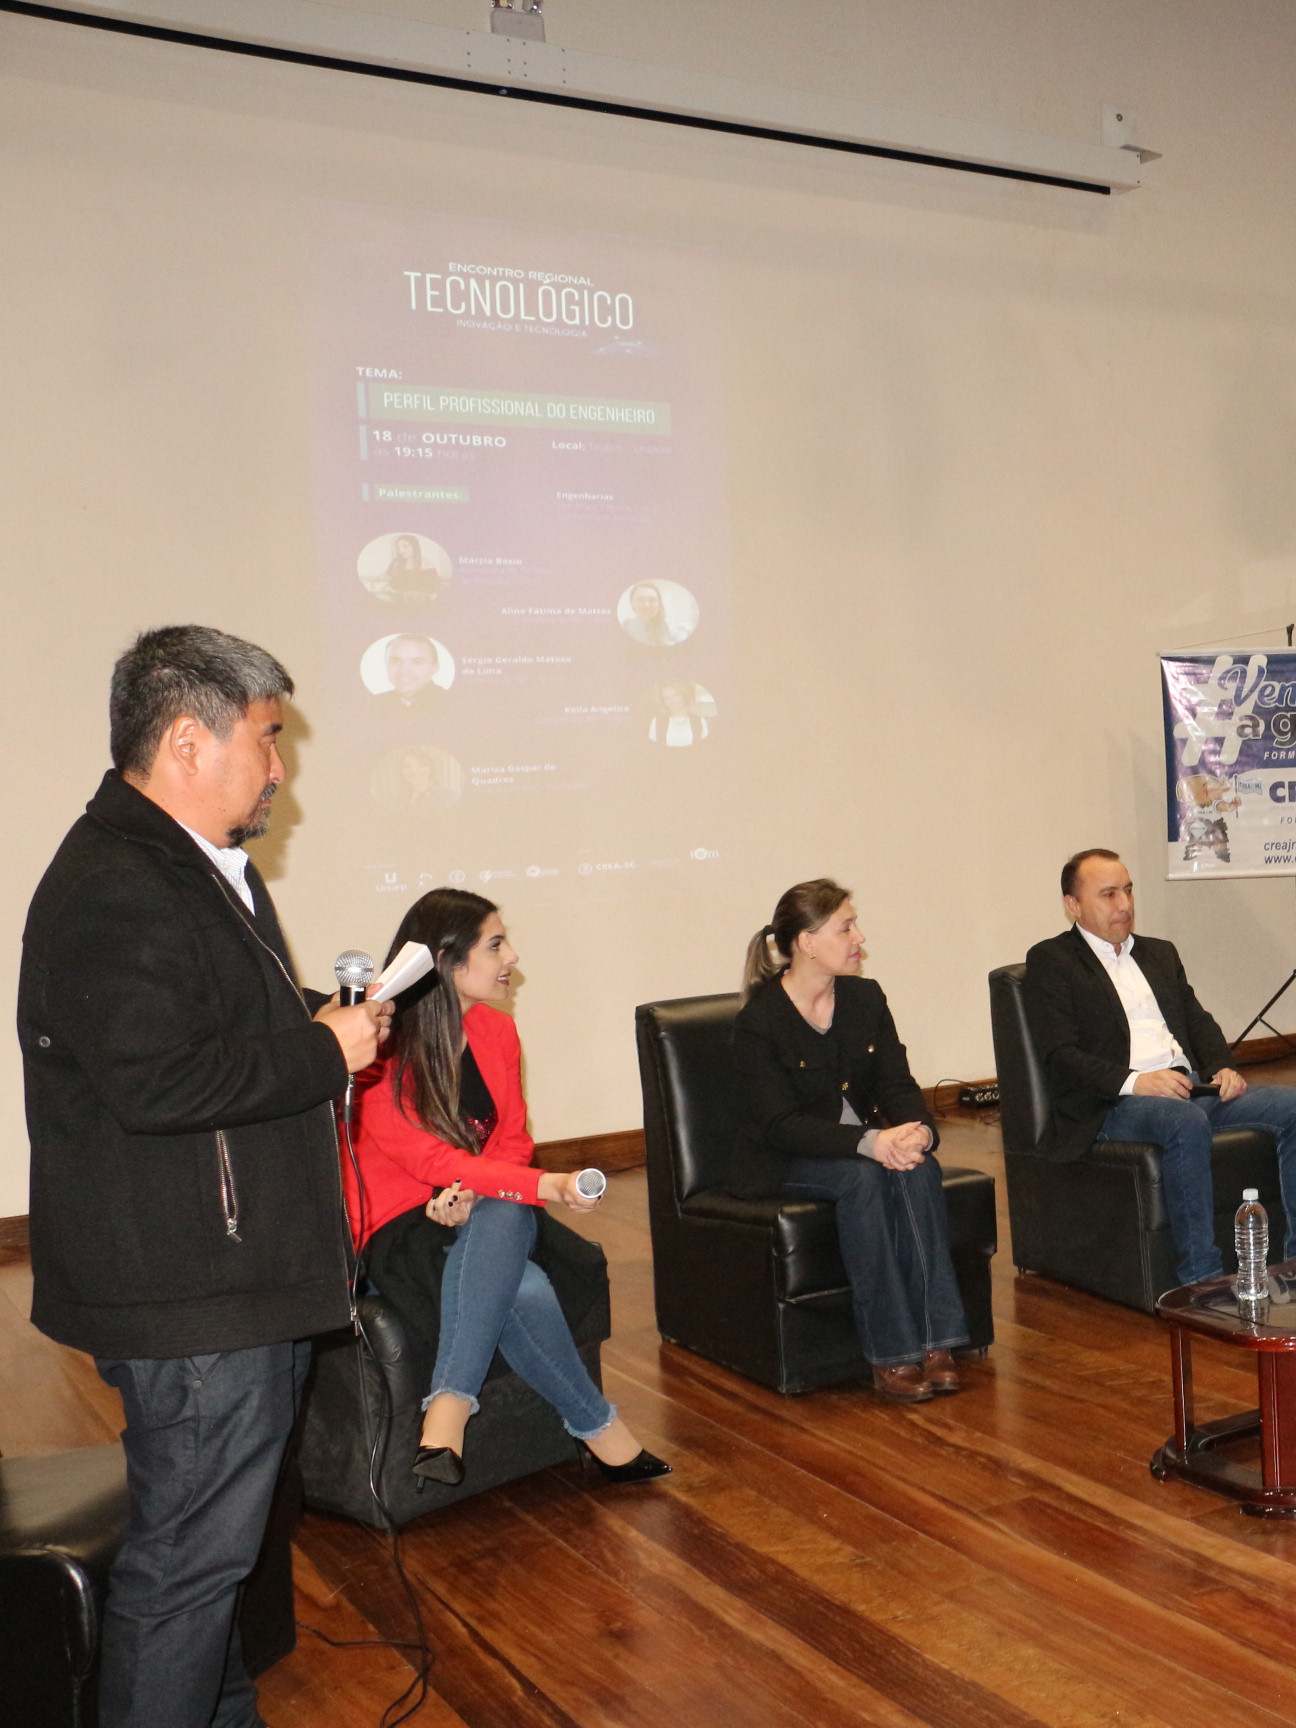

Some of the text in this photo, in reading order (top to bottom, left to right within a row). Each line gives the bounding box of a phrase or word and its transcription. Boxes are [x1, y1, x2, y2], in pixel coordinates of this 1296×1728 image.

[448, 262, 594, 286] ENCONTRO REGIONAL
[404, 271, 633, 330] TECNOLÓGICO
[524, 324, 587, 337] TECNOLOGIA
[356, 367, 402, 380] TEMA:
[384, 392, 655, 424] PERFIL PROFISSIONAL DO ENGENHEIRO
[373, 430, 507, 448] 18 de OUTUBRO
[394, 446, 433, 459] 19:15
[551, 440, 586, 452] Local:
[556, 491, 614, 502] Engenharias
[462, 668, 502, 676] de Lima
[1236, 713, 1262, 740] a
[544, 763, 556, 771] de
[471, 776, 514, 786] Quadros
